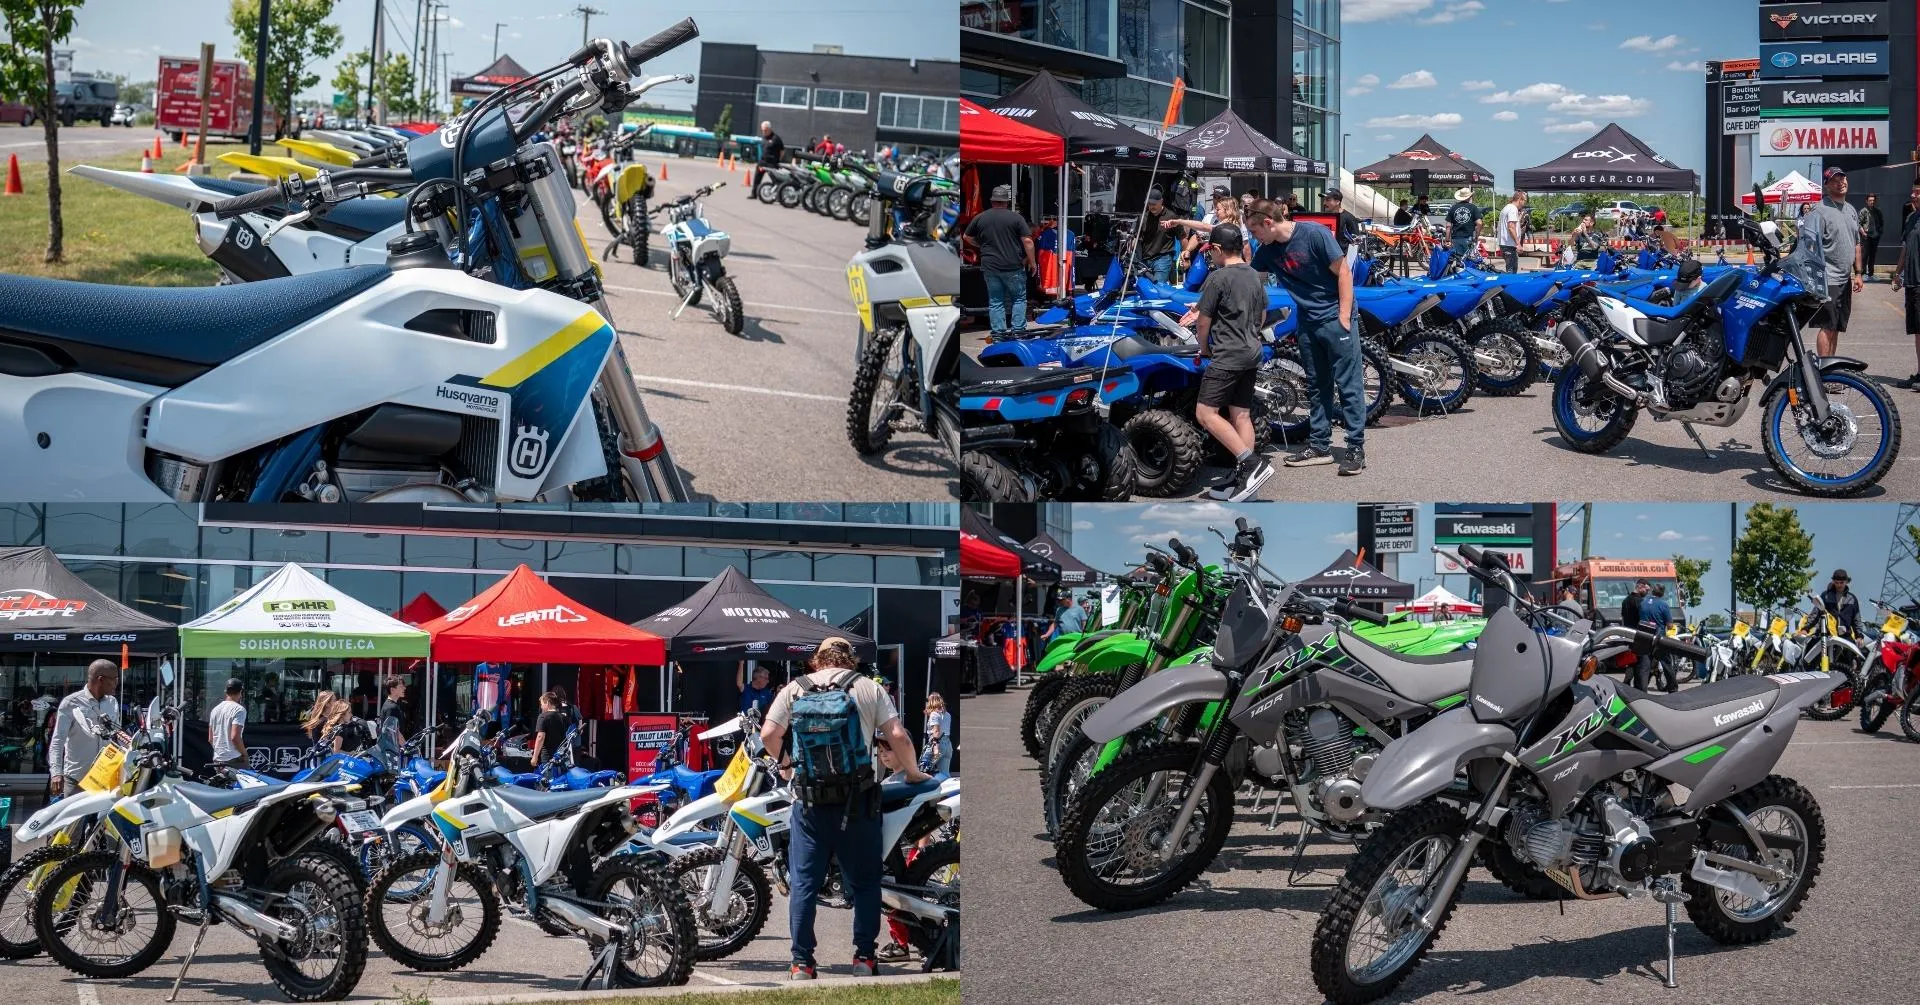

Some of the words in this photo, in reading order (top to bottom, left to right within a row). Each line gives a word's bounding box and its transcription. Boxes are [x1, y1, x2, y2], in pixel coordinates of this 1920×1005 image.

[1801, 14, 1877, 25] VICTORY
[1801, 53, 1877, 65] POLARIS
[1783, 89, 1864, 104] Kawasaki
[1794, 128, 1878, 149] YAMAHA
[1550, 175, 1655, 184] CKXGEAR.COM
[436, 385, 499, 407] Husqvarna
[1453, 523, 1515, 534] Kawasaki
[722, 607, 791, 620] MOTOVAN
[14, 633, 67, 641] POLARIS
[83, 634, 137, 642] GASGAS
[239, 639, 375, 650] SOISHORSROUTE.CA
[1250, 694, 1284, 719] 140R
[1475, 694, 1504, 715] Kawasaki
[1712, 699, 1765, 727] Kawasaki
[656, 731, 673, 740] LAND
[1553, 761, 1580, 782] 110R
